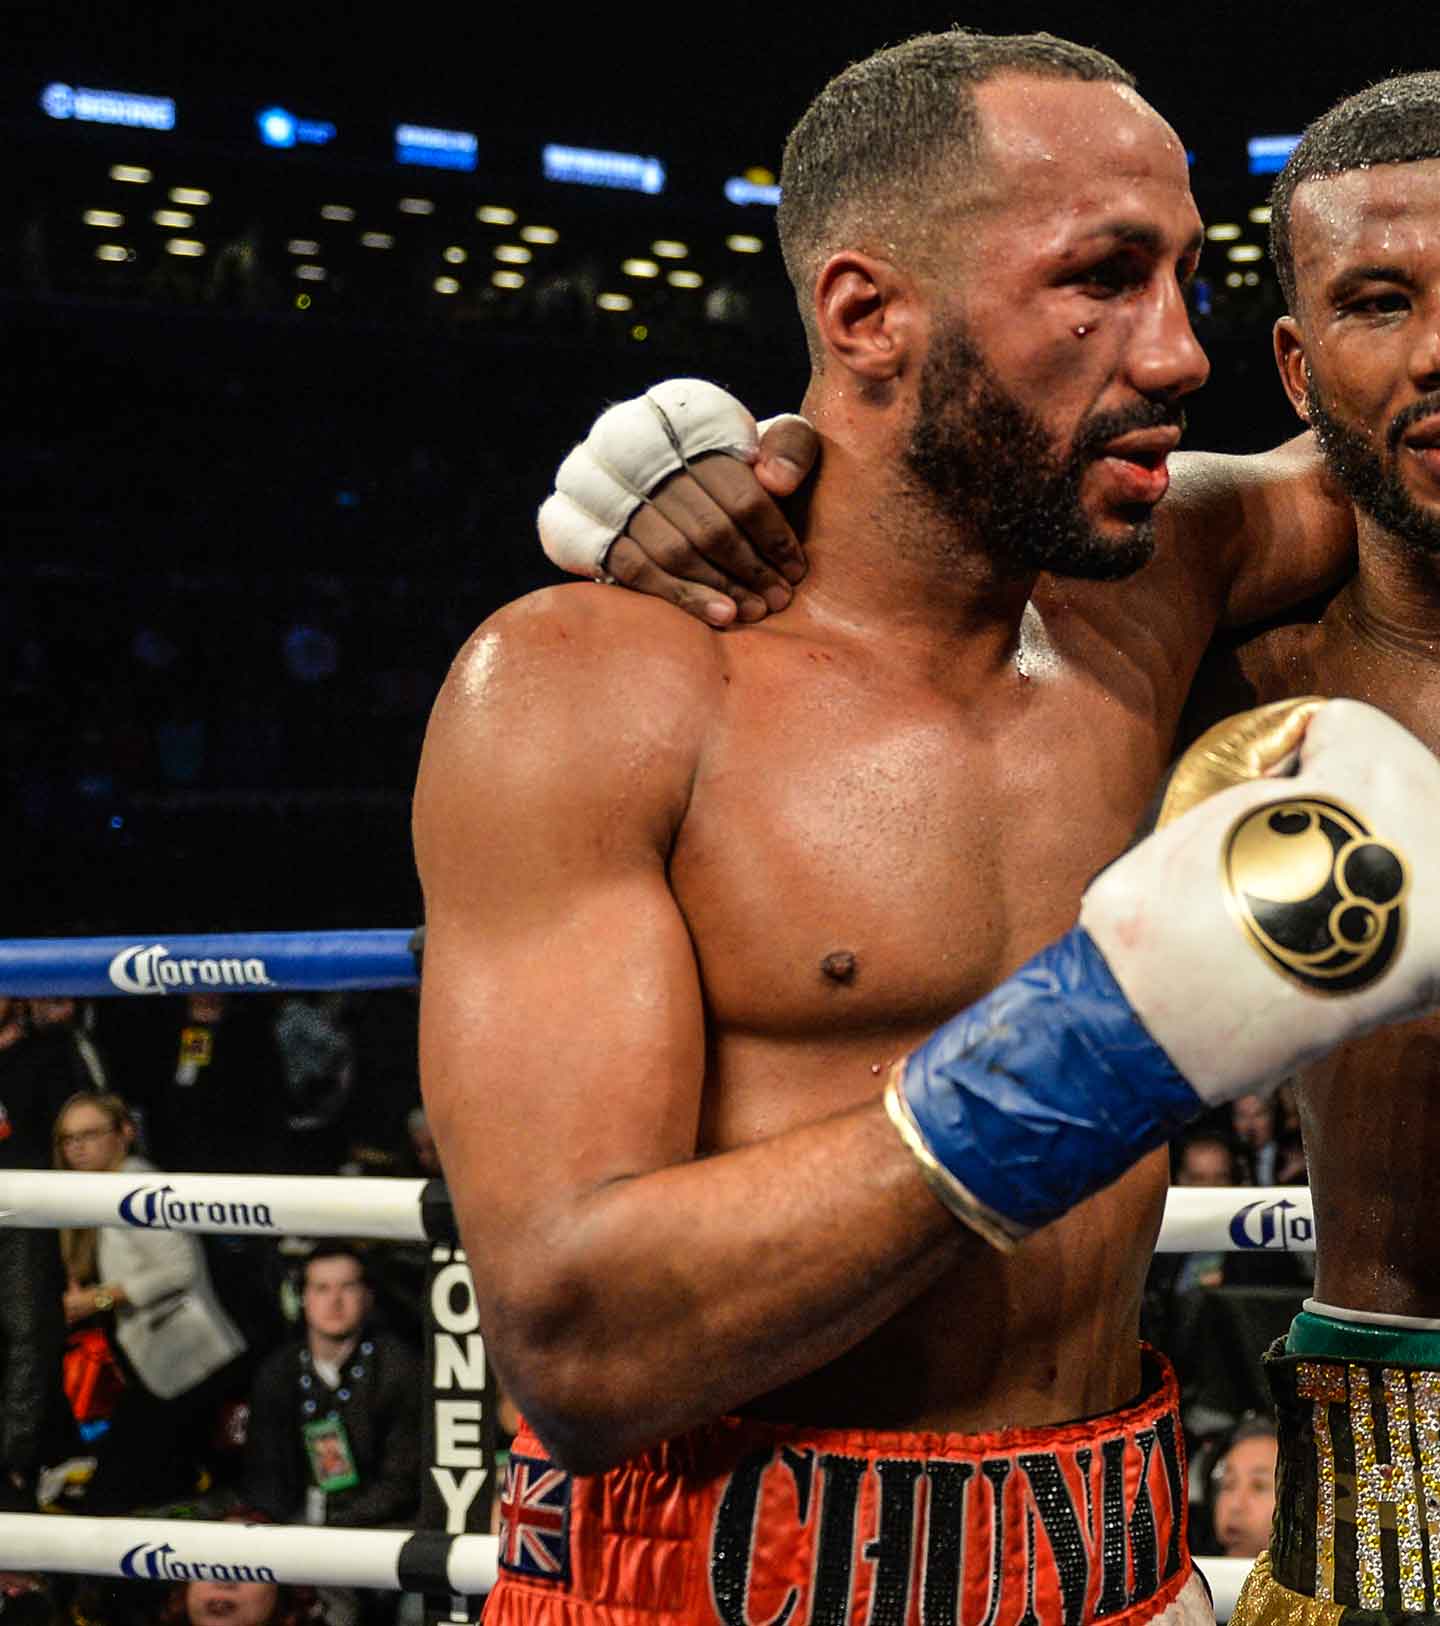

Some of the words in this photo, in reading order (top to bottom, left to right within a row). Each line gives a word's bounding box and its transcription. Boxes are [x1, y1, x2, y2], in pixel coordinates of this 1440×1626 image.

[109, 944, 271, 995] Corona
[119, 1185, 274, 1230] Corona
[431, 1247, 488, 1535] ONEY
[120, 1543, 278, 1584] Corona
